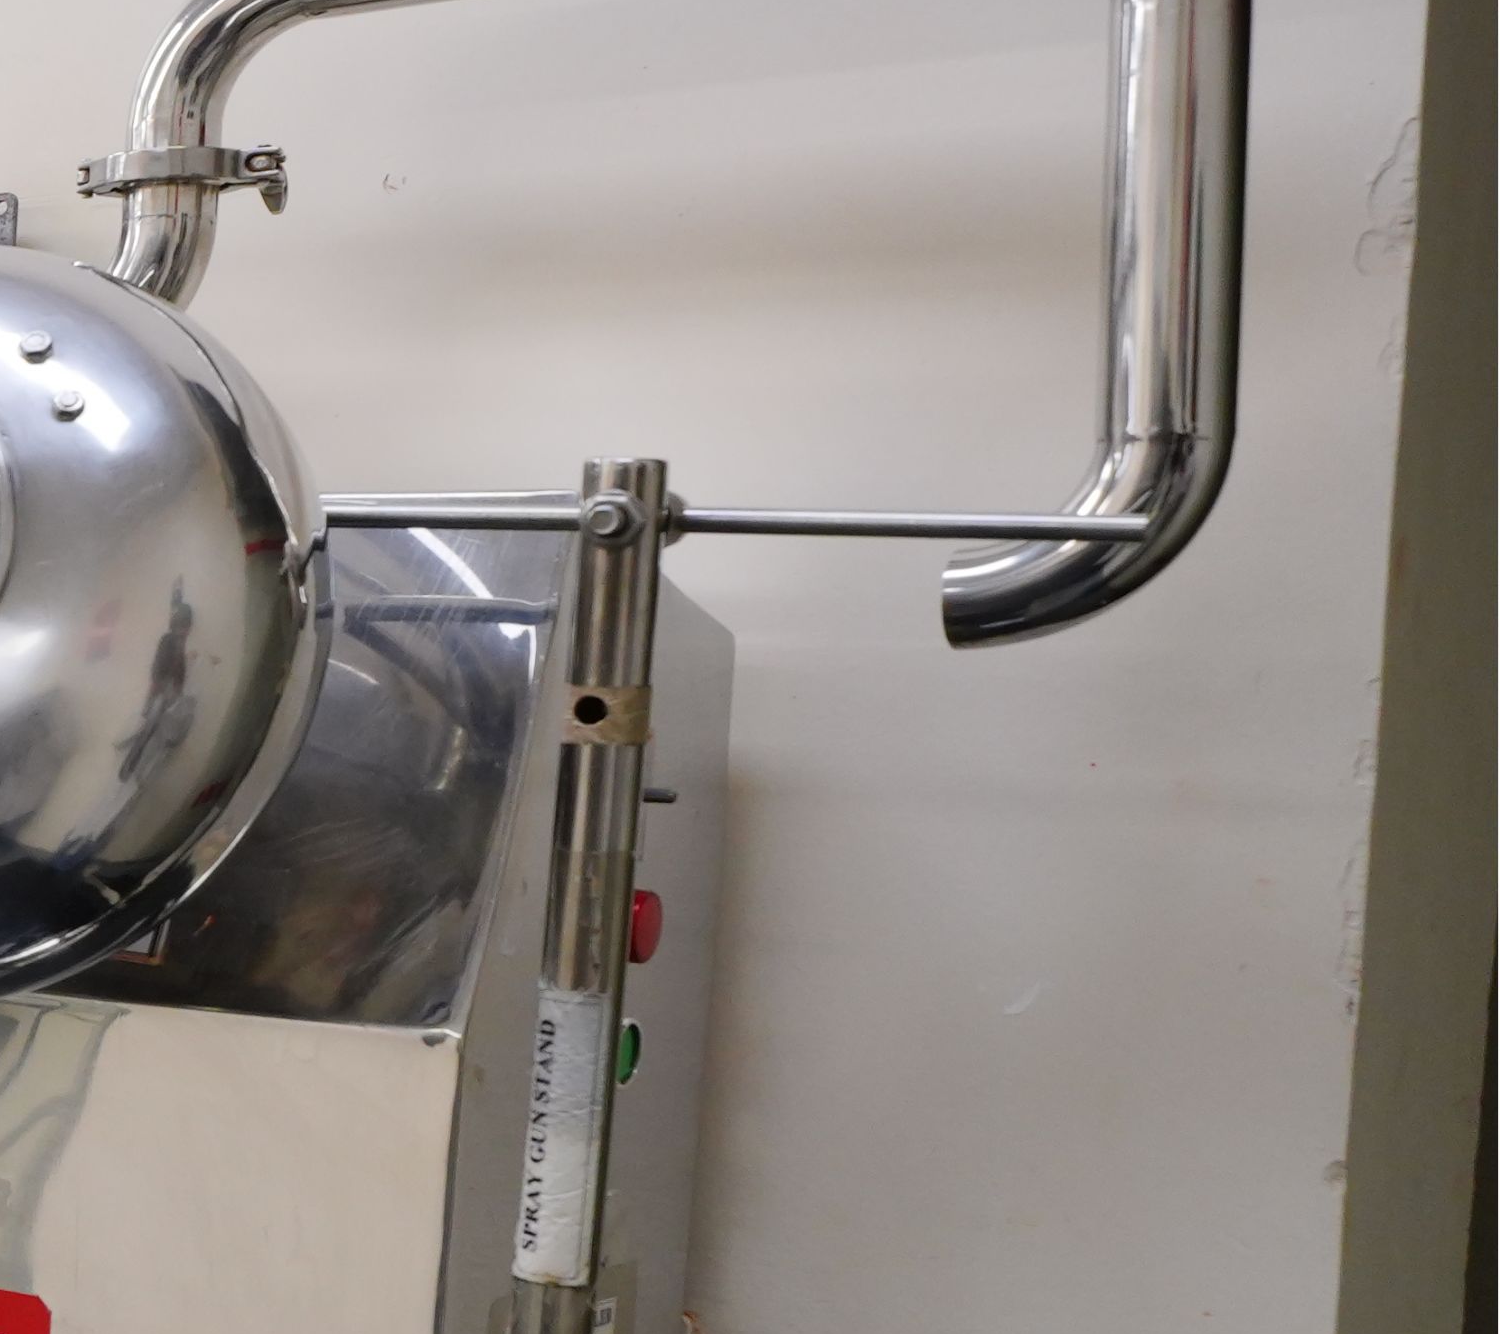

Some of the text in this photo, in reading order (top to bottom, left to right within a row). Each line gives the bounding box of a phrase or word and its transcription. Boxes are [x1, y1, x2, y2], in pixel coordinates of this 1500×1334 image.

[522, 1019, 556, 1252] SPRAY GUN STAND
